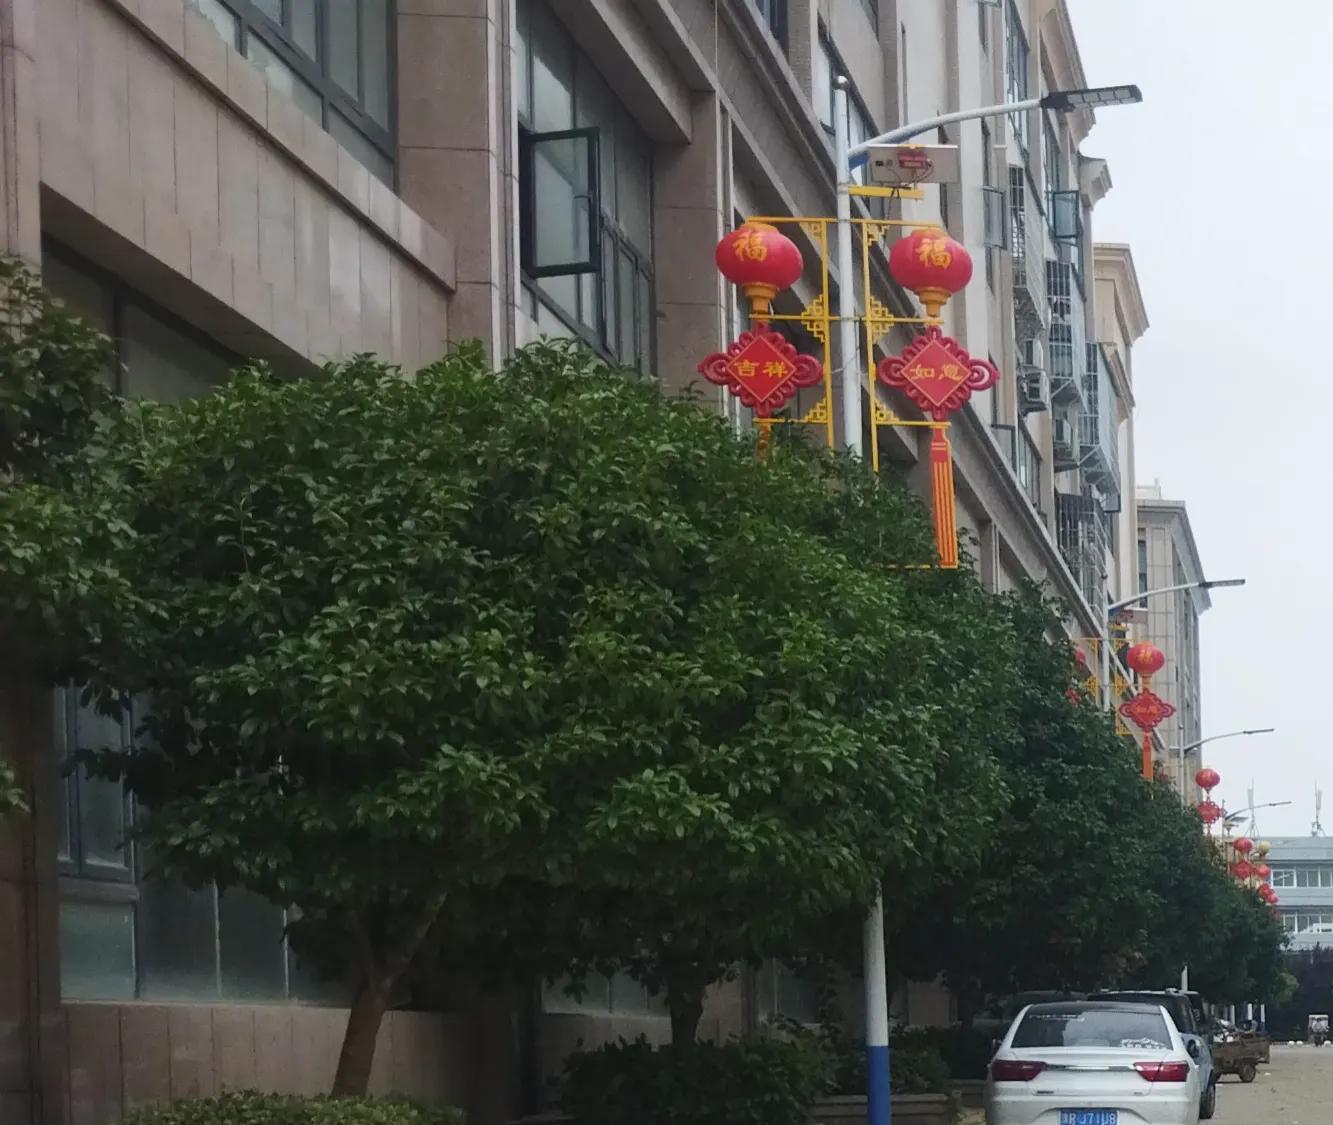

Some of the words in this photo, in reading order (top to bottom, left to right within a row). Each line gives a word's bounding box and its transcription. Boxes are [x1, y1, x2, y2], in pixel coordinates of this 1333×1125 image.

[732, 231, 768, 262] 福
[915, 238, 953, 269] 福
[734, 360, 788, 377] 吉祥
[909, 366, 962, 381] 如意
